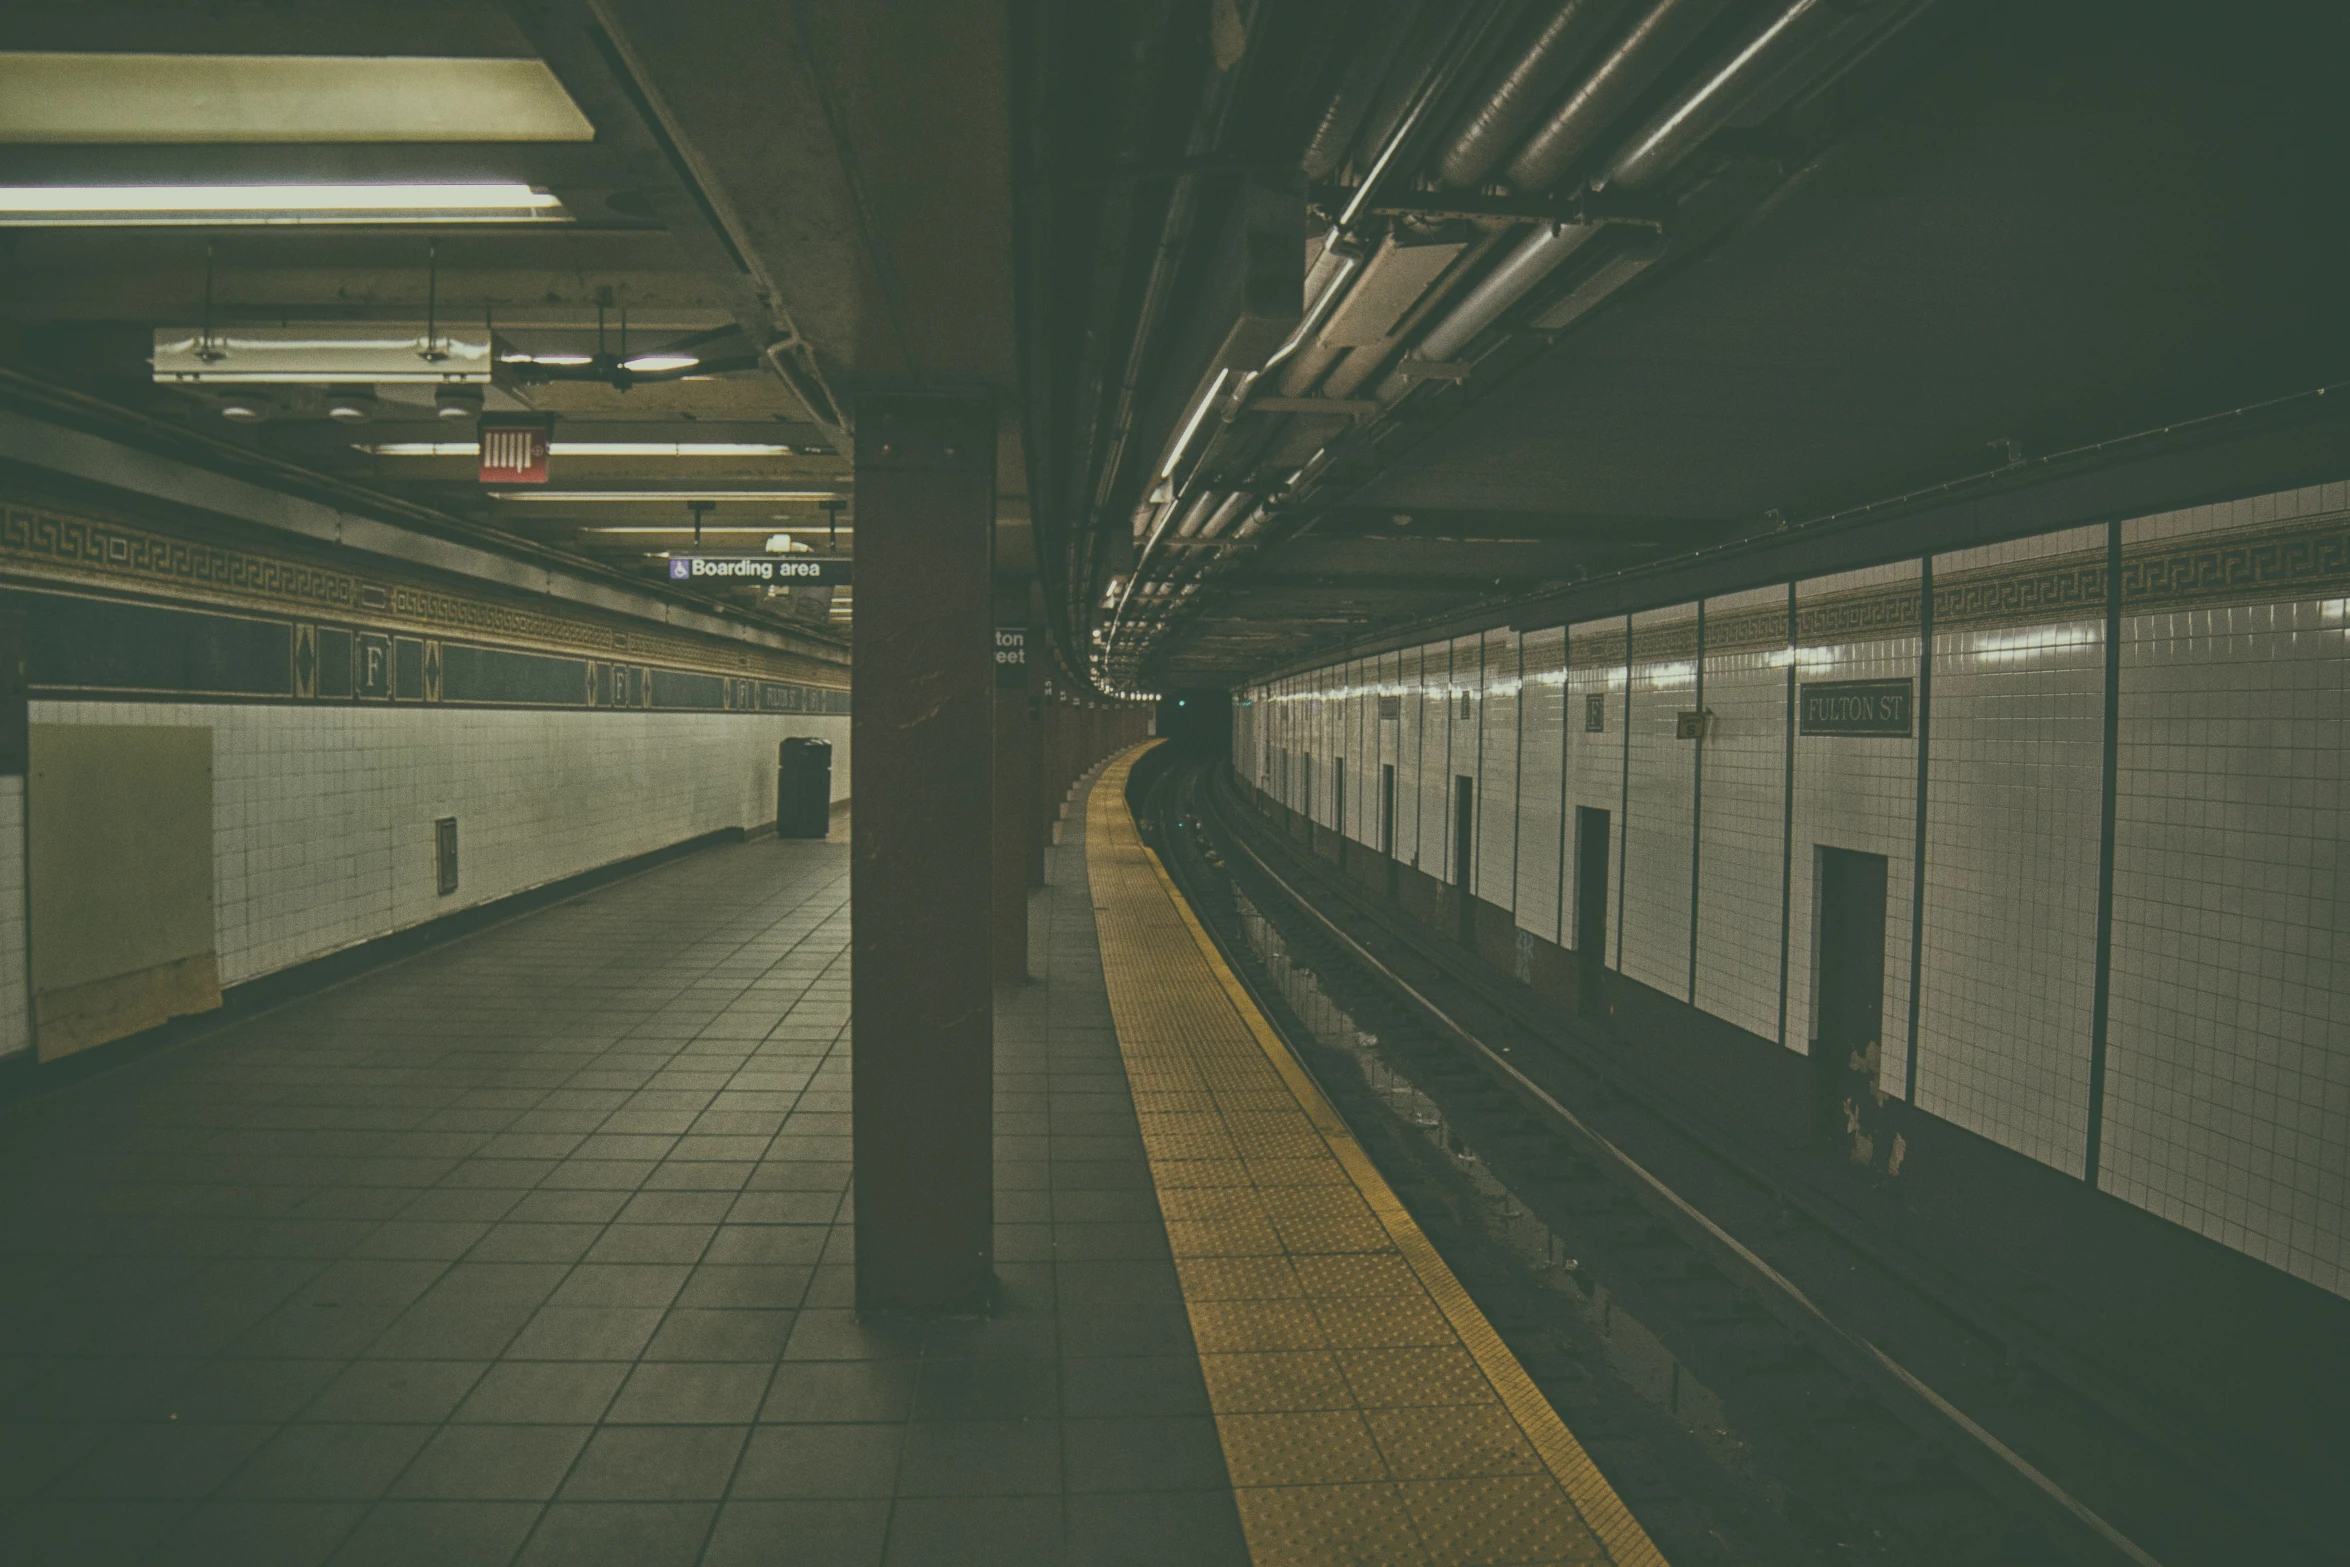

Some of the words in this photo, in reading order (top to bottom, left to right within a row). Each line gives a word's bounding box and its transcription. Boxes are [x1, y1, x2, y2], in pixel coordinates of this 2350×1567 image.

[692, 559, 773, 580] Boarding
[780, 562, 821, 577] area
[366, 646, 383, 687] F
[1808, 696, 1875, 721] FULTON
[1879, 695, 1903, 721] ST
